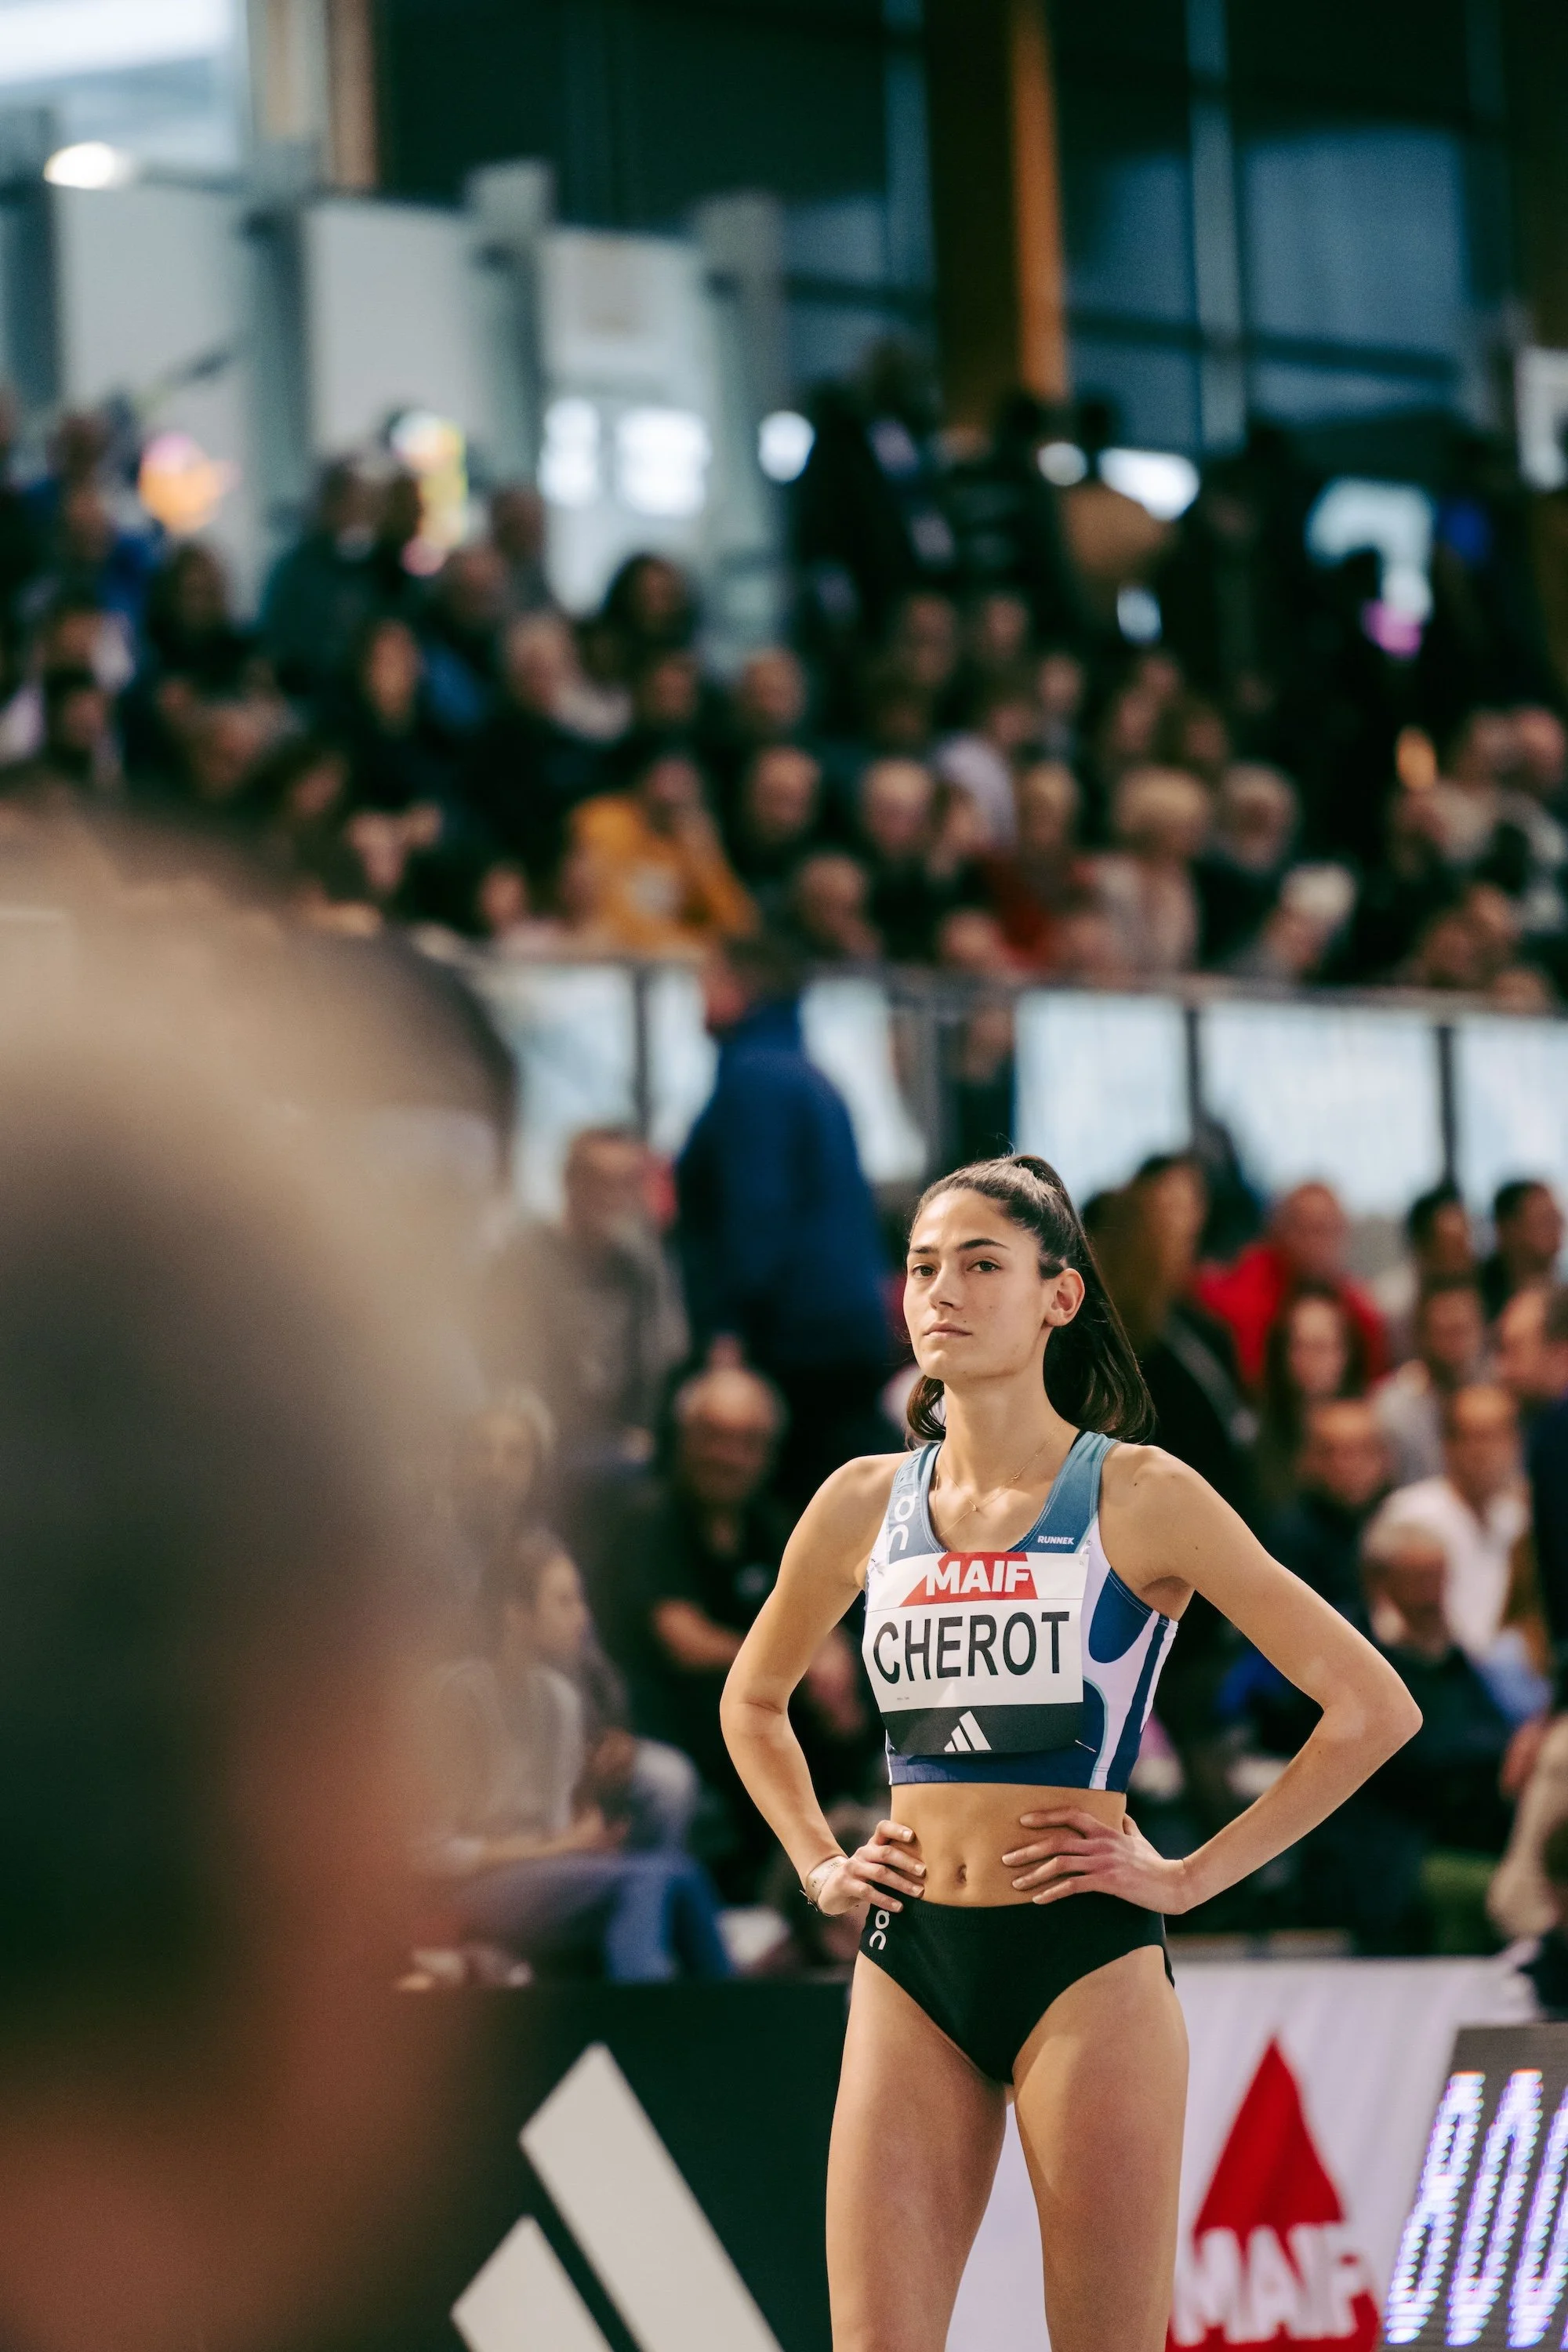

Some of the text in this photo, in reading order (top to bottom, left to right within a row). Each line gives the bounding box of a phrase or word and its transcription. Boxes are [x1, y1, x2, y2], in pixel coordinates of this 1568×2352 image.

[1037, 1535, 1075, 1545] RUNNEK
[924, 1560, 1030, 1596] MAIF
[873, 1610, 1071, 1684] CHEROT
[1174, 2222, 1372, 2345] MAIF
